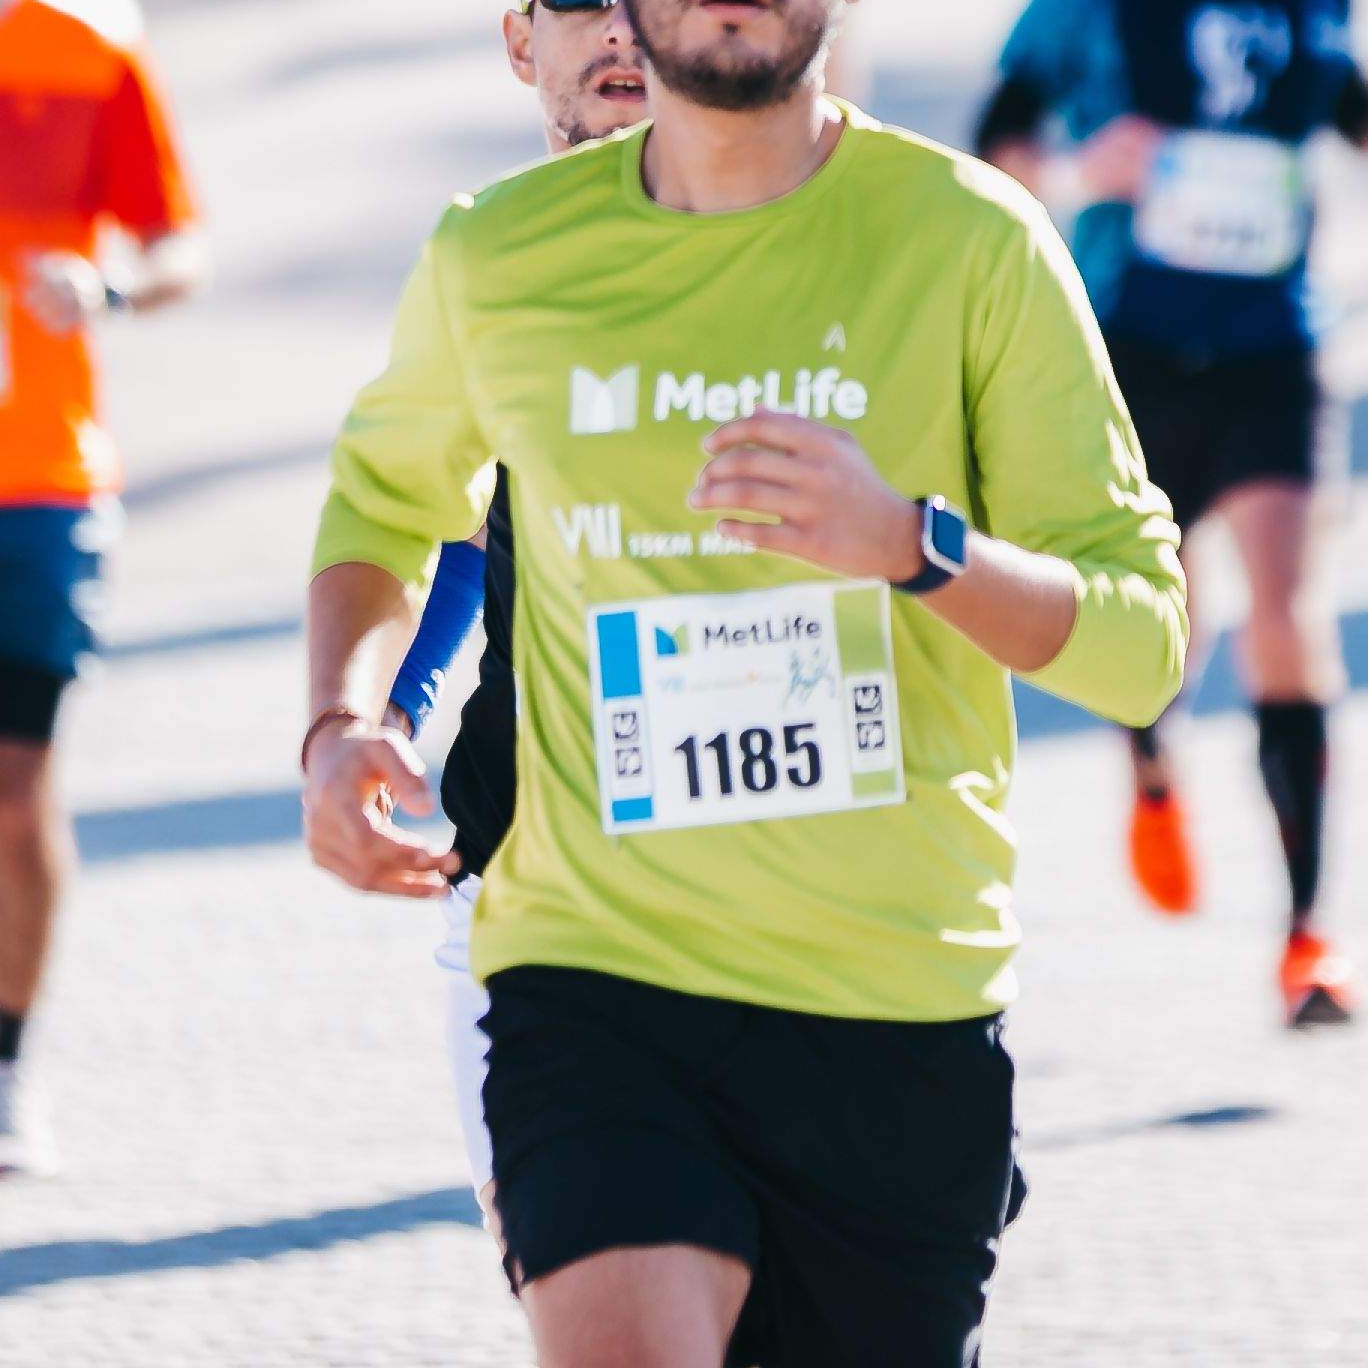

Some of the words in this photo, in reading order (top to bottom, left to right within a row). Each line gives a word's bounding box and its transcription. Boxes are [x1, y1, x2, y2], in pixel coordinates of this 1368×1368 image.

[654, 367, 868, 422] MetLife
[704, 614, 822, 649] MetLife
[674, 722, 823, 798] 1185
